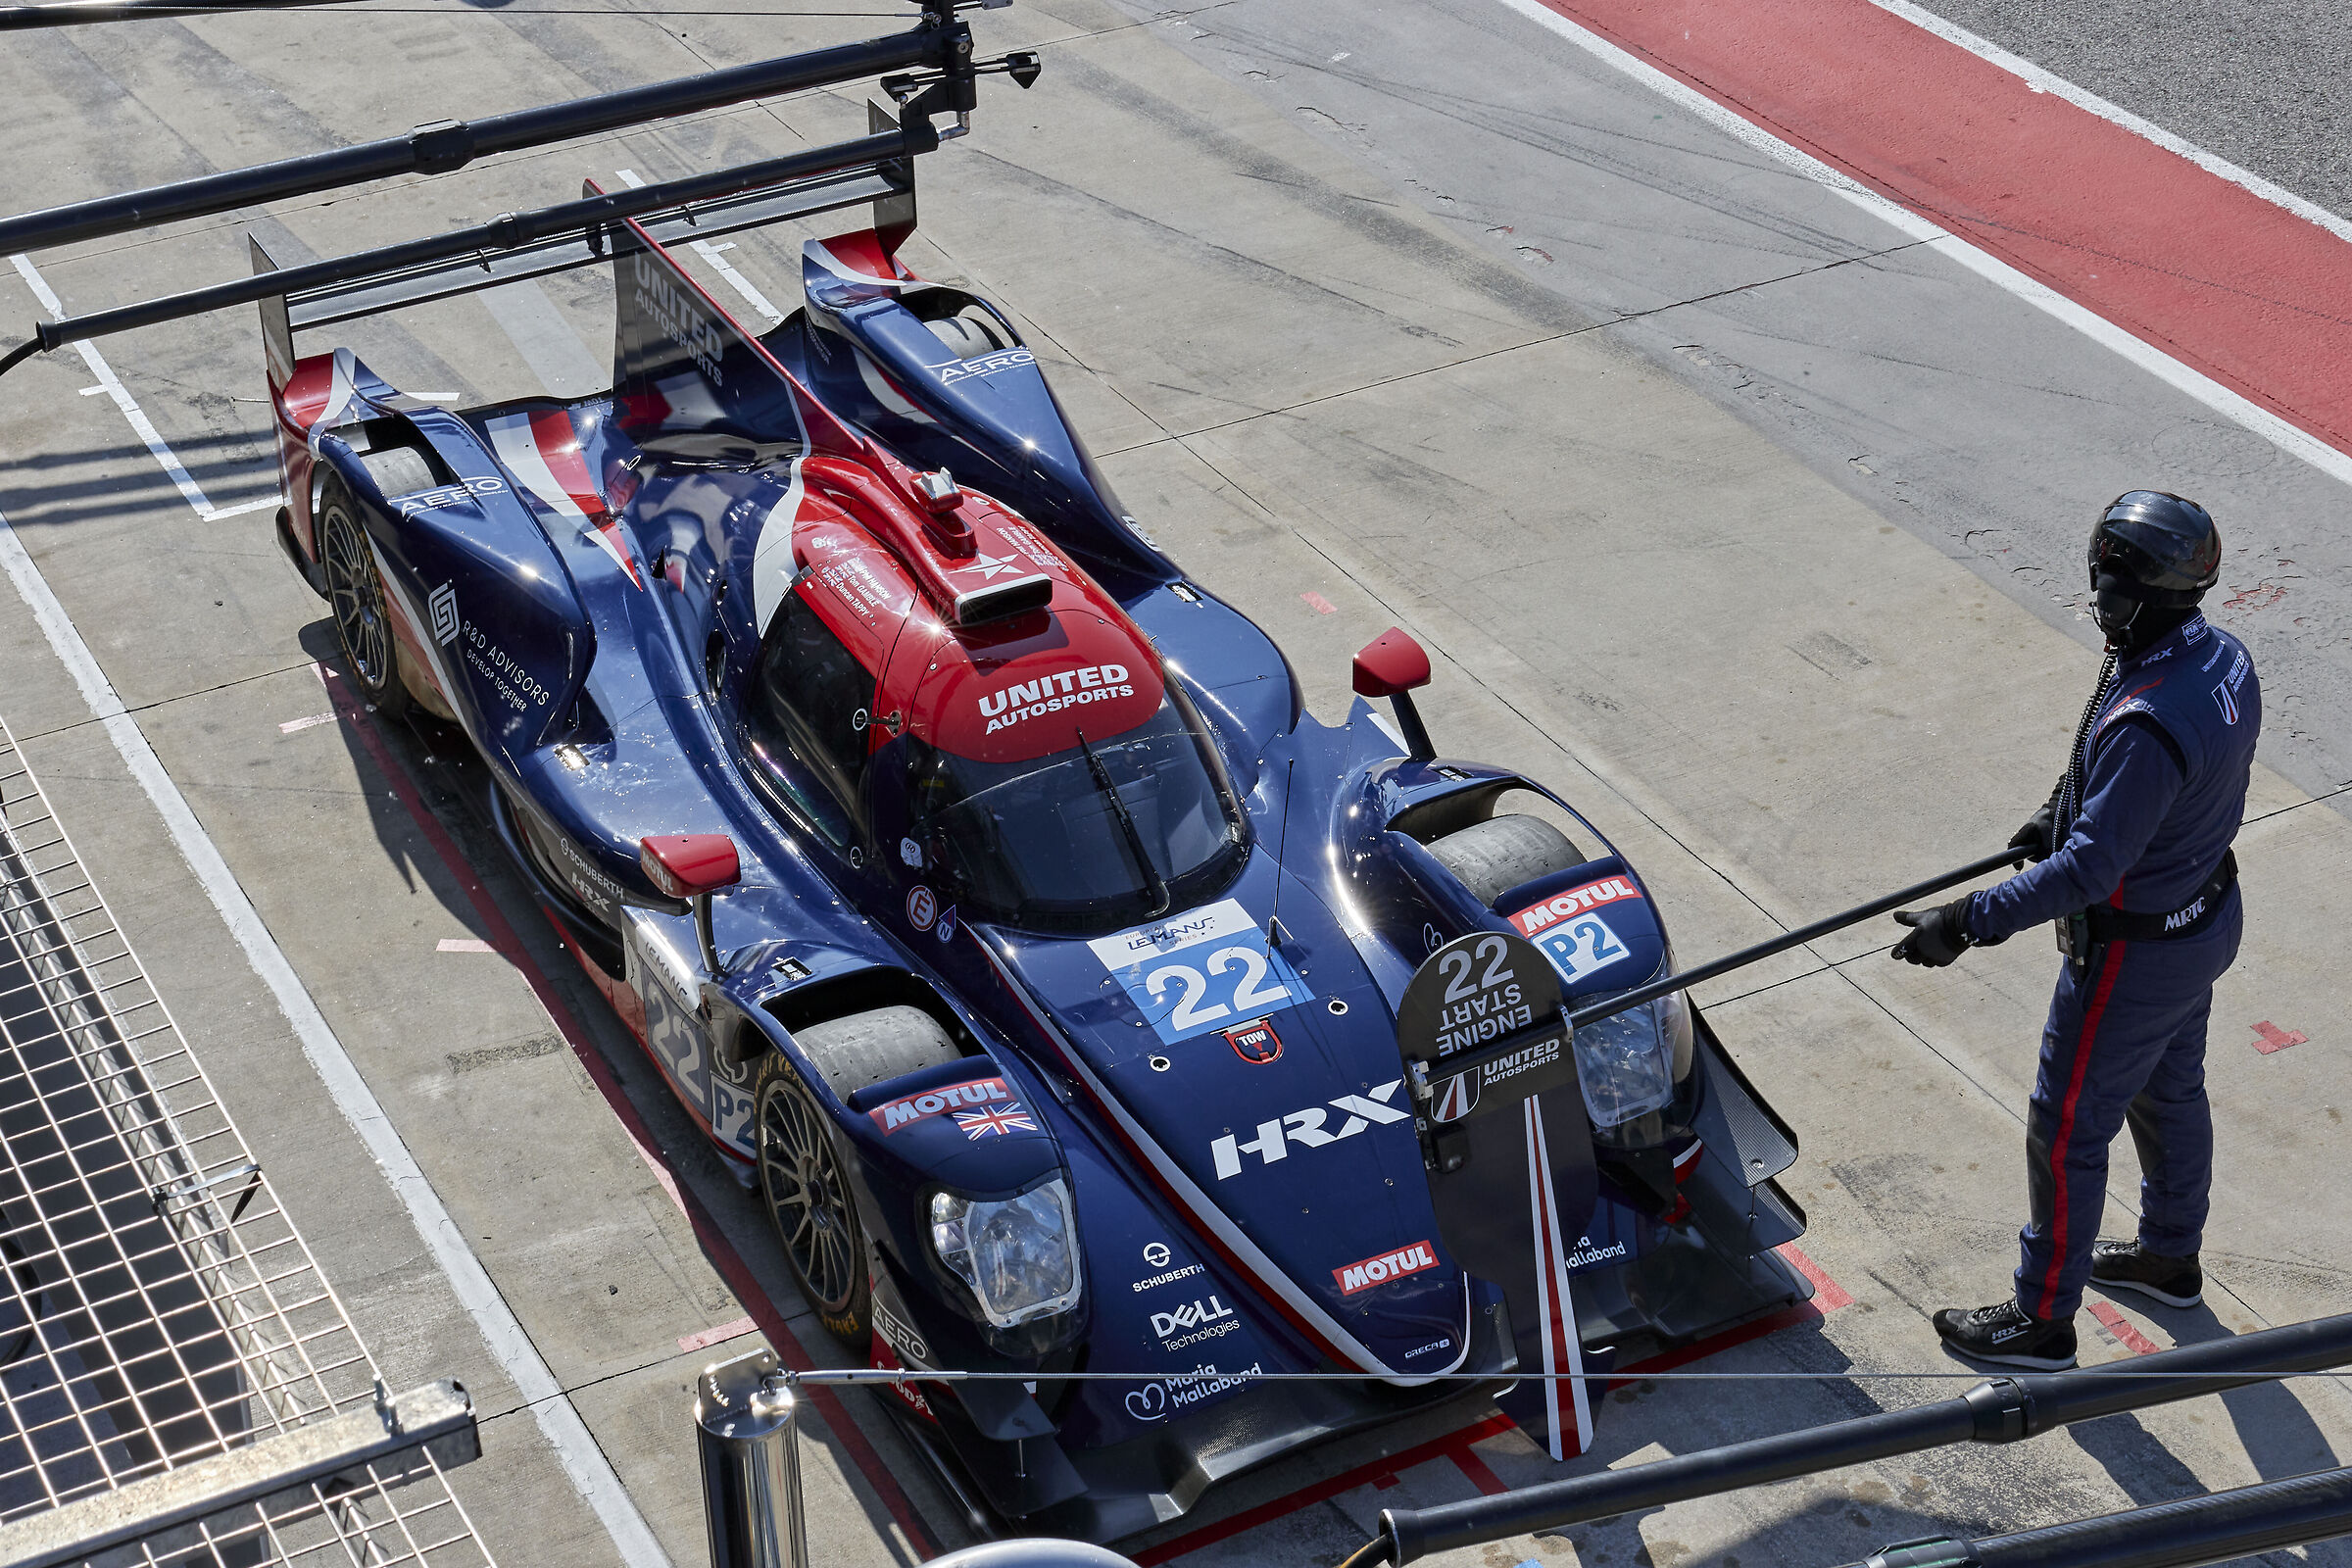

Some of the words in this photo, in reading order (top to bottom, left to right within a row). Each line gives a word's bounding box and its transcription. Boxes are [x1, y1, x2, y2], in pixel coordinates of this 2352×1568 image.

[635, 251, 722, 362] UNITED
[635, 288, 722, 386] AUTOSPORTS
[941, 352, 1034, 382] AERO
[401, 479, 503, 517] AERO
[836, 581, 855, 603] Duncan
[852, 598, 870, 616] TAPPY
[848, 574, 859, 588] Tom
[857, 585, 880, 608] GAMBLE
[463, 620, 486, 649] R&D
[487, 646, 550, 706] ADVISORS
[466, 649, 495, 680] DEVELOP
[494, 676, 527, 712] TOGETHER
[978, 663, 1129, 717] UNITED
[985, 685, 1134, 735] AUTOSPORTS
[569, 851, 624, 899] SCHUBERTH
[571, 872, 611, 912] HRX
[642, 850, 674, 892] MOTUL
[1522, 879, 1634, 936] MOTUL
[1169, 934, 1198, 947] SERIES
[1540, 921, 1623, 977] P2
[1146, 947, 1293, 1031] 22
[1438, 935, 1514, 1004] 22
[1436, 1004, 1533, 1057] ENGINE
[1439, 983, 1522, 1031] START
[648, 982, 705, 1103] 22
[1238, 1030, 1267, 1048] TOW
[1484, 1038, 1560, 1076] UNITED
[1484, 1052, 1559, 1086] AUTOSPORTS
[713, 1081, 756, 1146] P2
[884, 1081, 1007, 1130] MOTUL
[1210, 1078, 1411, 1181] HRX
[1132, 1263, 1205, 1293] SCHUBERTH
[1343, 1246, 1433, 1291] MOTUL
[1565, 1240, 1626, 1269] allaband
[874, 1306, 926, 1359] AERO
[1151, 1296, 1234, 1338] DELL
[1162, 1319, 1241, 1352] Technologies
[1991, 1325, 2017, 1340] HRX
